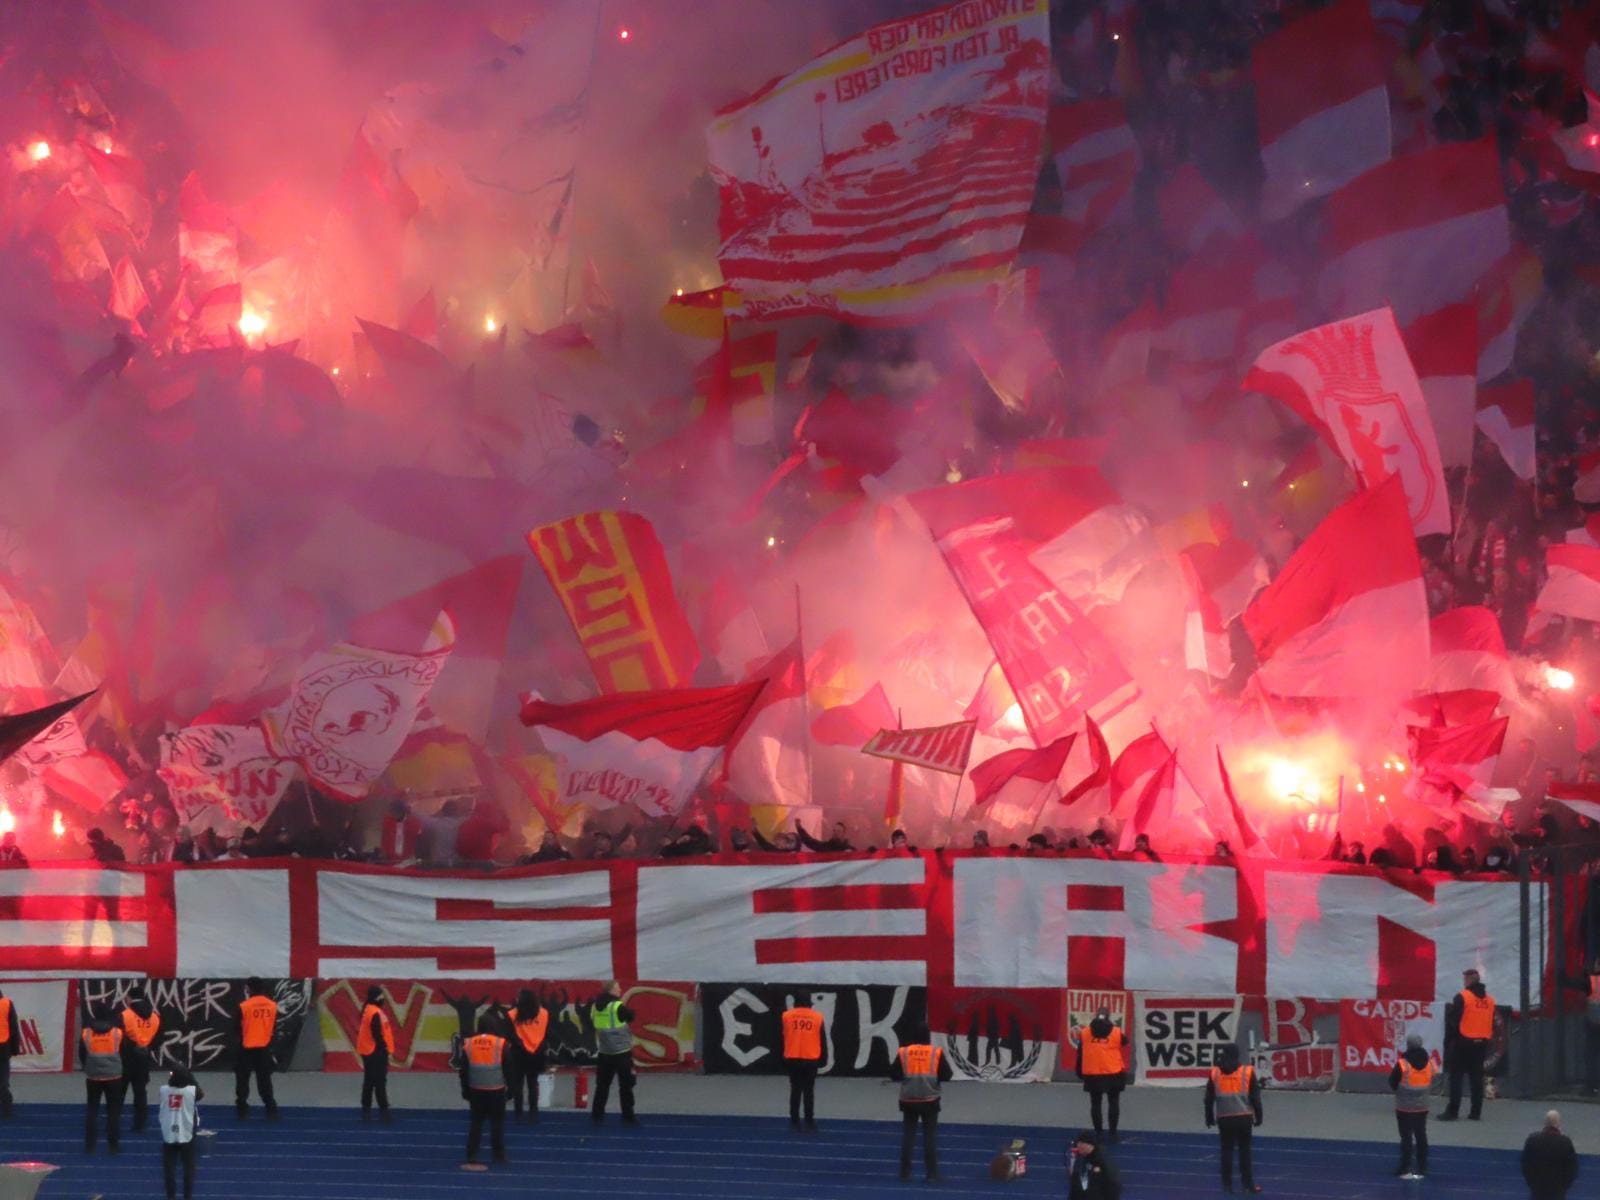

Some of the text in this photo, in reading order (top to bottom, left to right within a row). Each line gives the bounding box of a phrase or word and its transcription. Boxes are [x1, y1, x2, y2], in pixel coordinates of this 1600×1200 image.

[84, 979, 232, 1021] HAMER
[1353, 999, 1433, 1020] GARDE
[792, 1019, 813, 1031] 190
[1145, 1010, 1233, 1041] SEK
